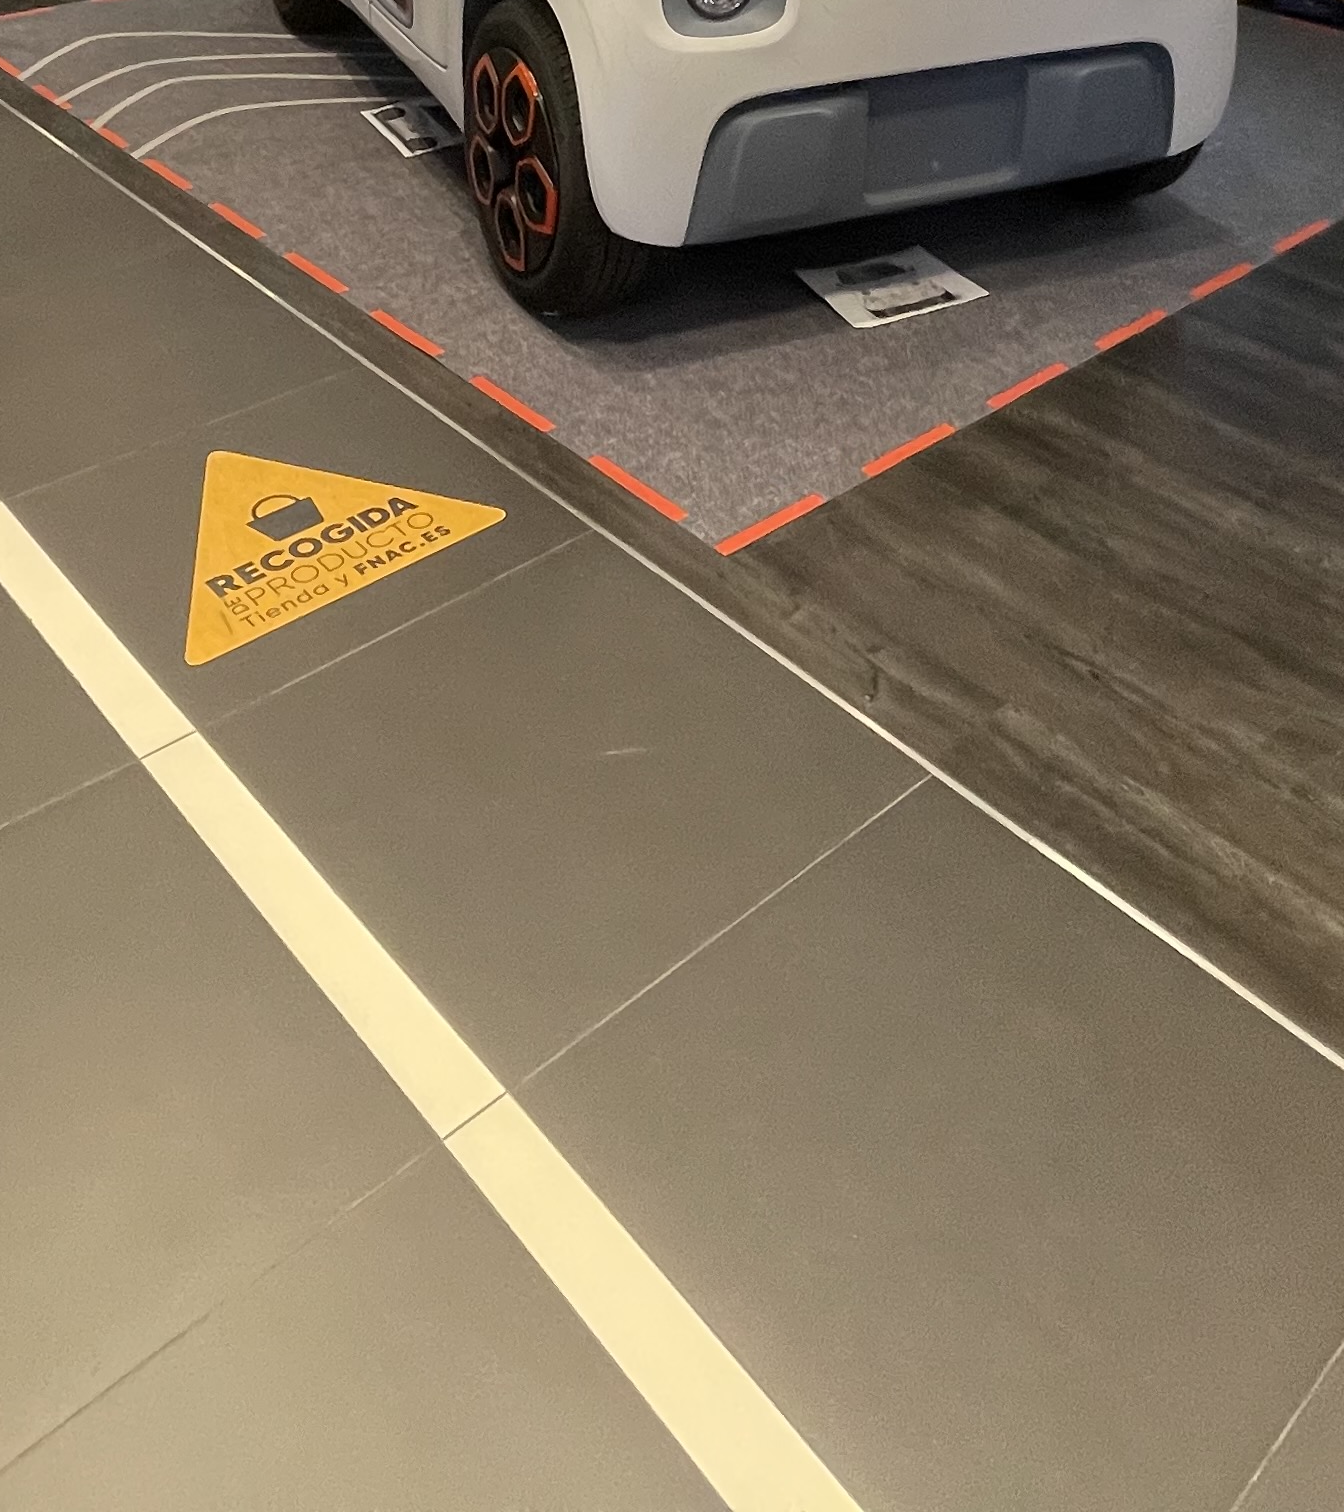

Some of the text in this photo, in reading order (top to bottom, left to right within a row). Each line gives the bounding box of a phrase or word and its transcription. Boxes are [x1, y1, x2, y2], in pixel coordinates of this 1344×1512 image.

[206, 496, 420, 599] RECOGIDA
[239, 525, 452, 628] Tienda y FNAC.ES
[245, 511, 434, 607] PRODUCTO
